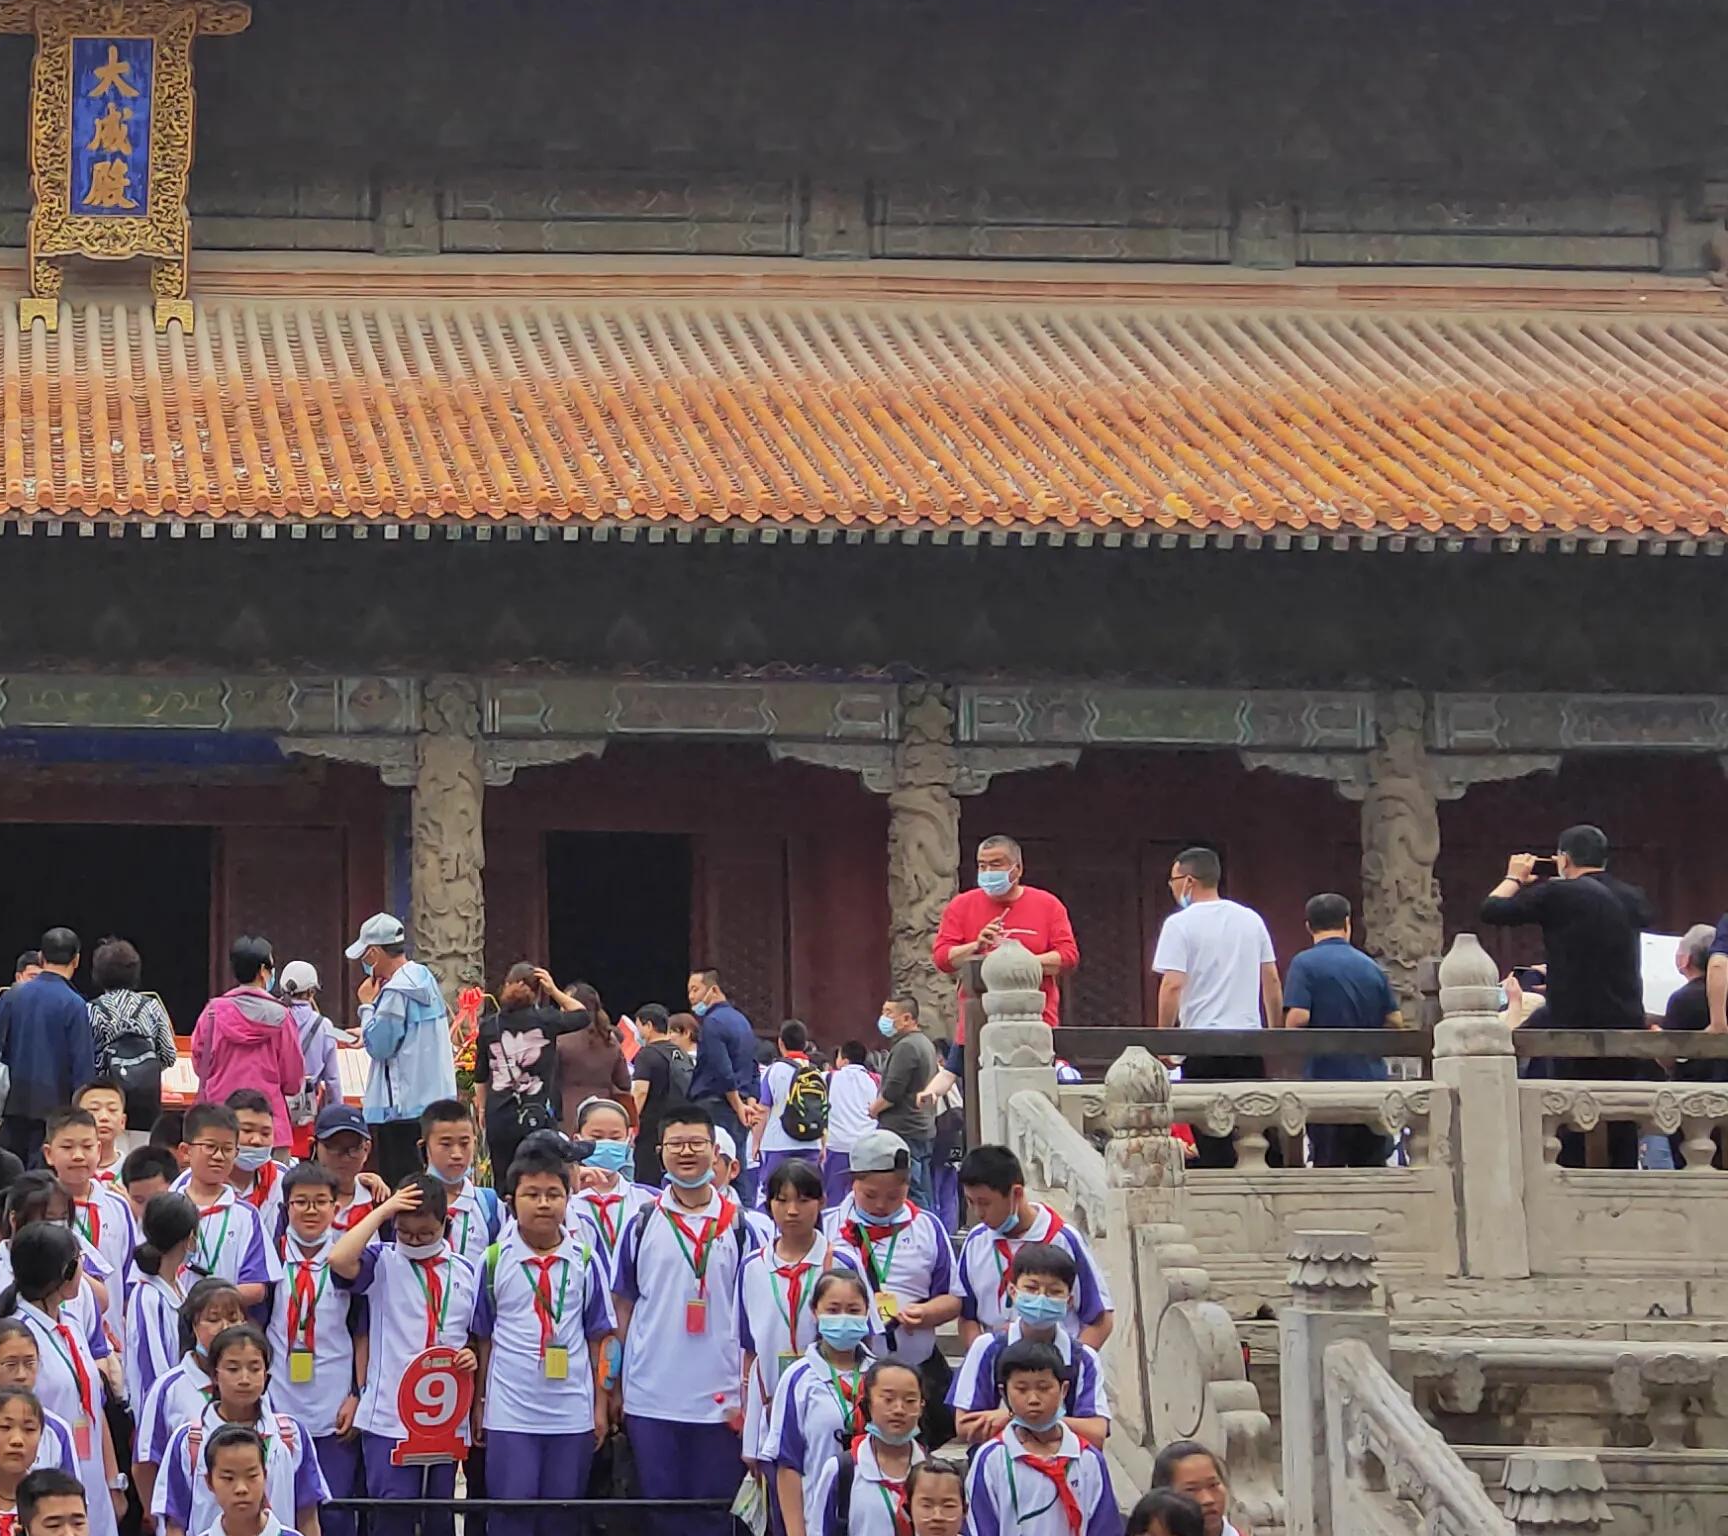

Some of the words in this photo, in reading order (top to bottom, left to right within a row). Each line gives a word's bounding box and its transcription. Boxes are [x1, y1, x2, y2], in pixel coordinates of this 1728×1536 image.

[80, 44, 141, 209] 大成殿
[413, 1371, 459, 1426] 9
